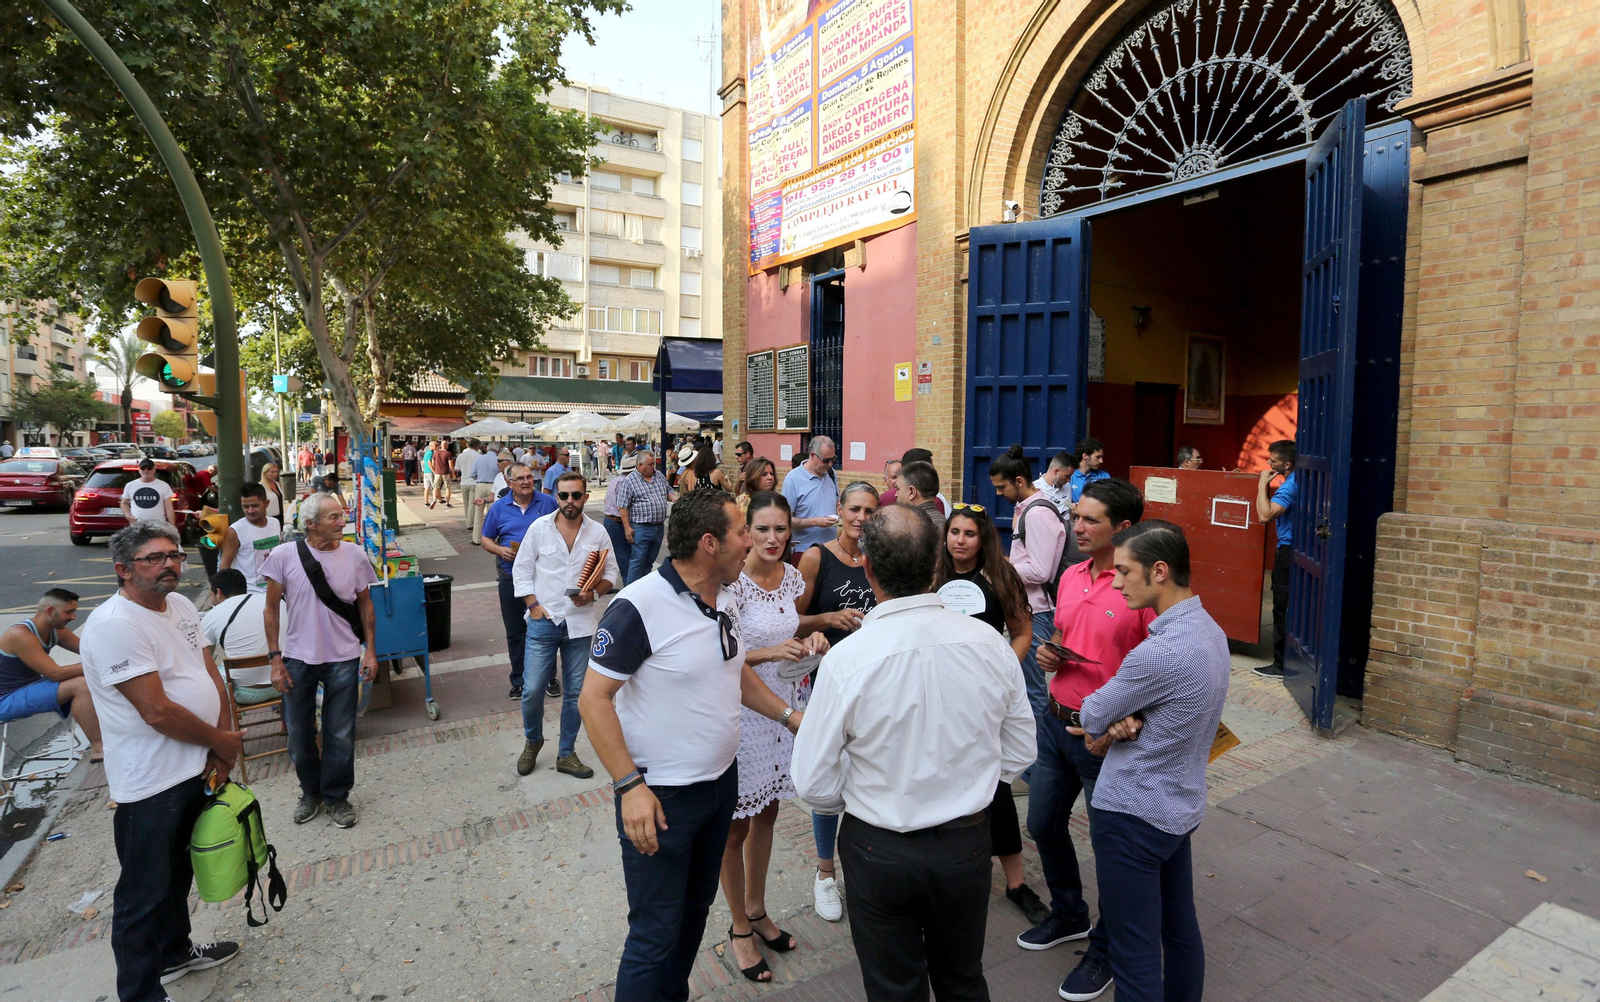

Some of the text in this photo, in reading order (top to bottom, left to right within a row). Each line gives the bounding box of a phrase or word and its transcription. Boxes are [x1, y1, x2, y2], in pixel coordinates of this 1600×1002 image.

[783, 32, 806, 52] Agosto
[821, 20, 838, 34] Gran
[822, 21, 862, 55] MORANTE
[837, 2, 906, 56] MANZANARES
[822, 54, 848, 78] DAVID
[850, 50, 858, 60] de
[860, 16, 907, 54] MIRANDA
[861, 64, 869, 77] 5
[870, 45, 905, 70] Agosto
[777, 59, 810, 88] SILVERA
[822, 57, 908, 111] Gran Corrida de Rejones
[771, 81, 810, 108] CADAVAL
[822, 80, 909, 133] ANDY CARTAGENA
[771, 118, 778, 128] 4
[780, 106, 805, 125] Agosto
[794, 116, 810, 128] Toros
[822, 122, 852, 144] DIEGO
[855, 92, 909, 127] VENTURA
[822, 130, 860, 156] ANDRES
[864, 105, 909, 135] ROMERO
[788, 171, 814, 184] FESTEJOS
[858, 146, 868, 154] LAS
[894, 123, 914, 137] TARDE
[844, 154, 864, 168] LOS
[867, 130, 915, 158] PRECIOS
[755, 171, 778, 187] ROCA
[780, 160, 798, 174] REY
[784, 190, 806, 205] Telf.
[811, 178, 835, 194] 959
[840, 169, 855, 182] 28
[861, 158, 876, 172] 15
[882, 148, 901, 163] 00
[785, 166, 902, 218] www.plazadetorosdehuelva.es
[788, 200, 844, 229] COMPLEJO
[847, 180, 901, 206] RAFAEL
[593, 631, 609, 657] 3
